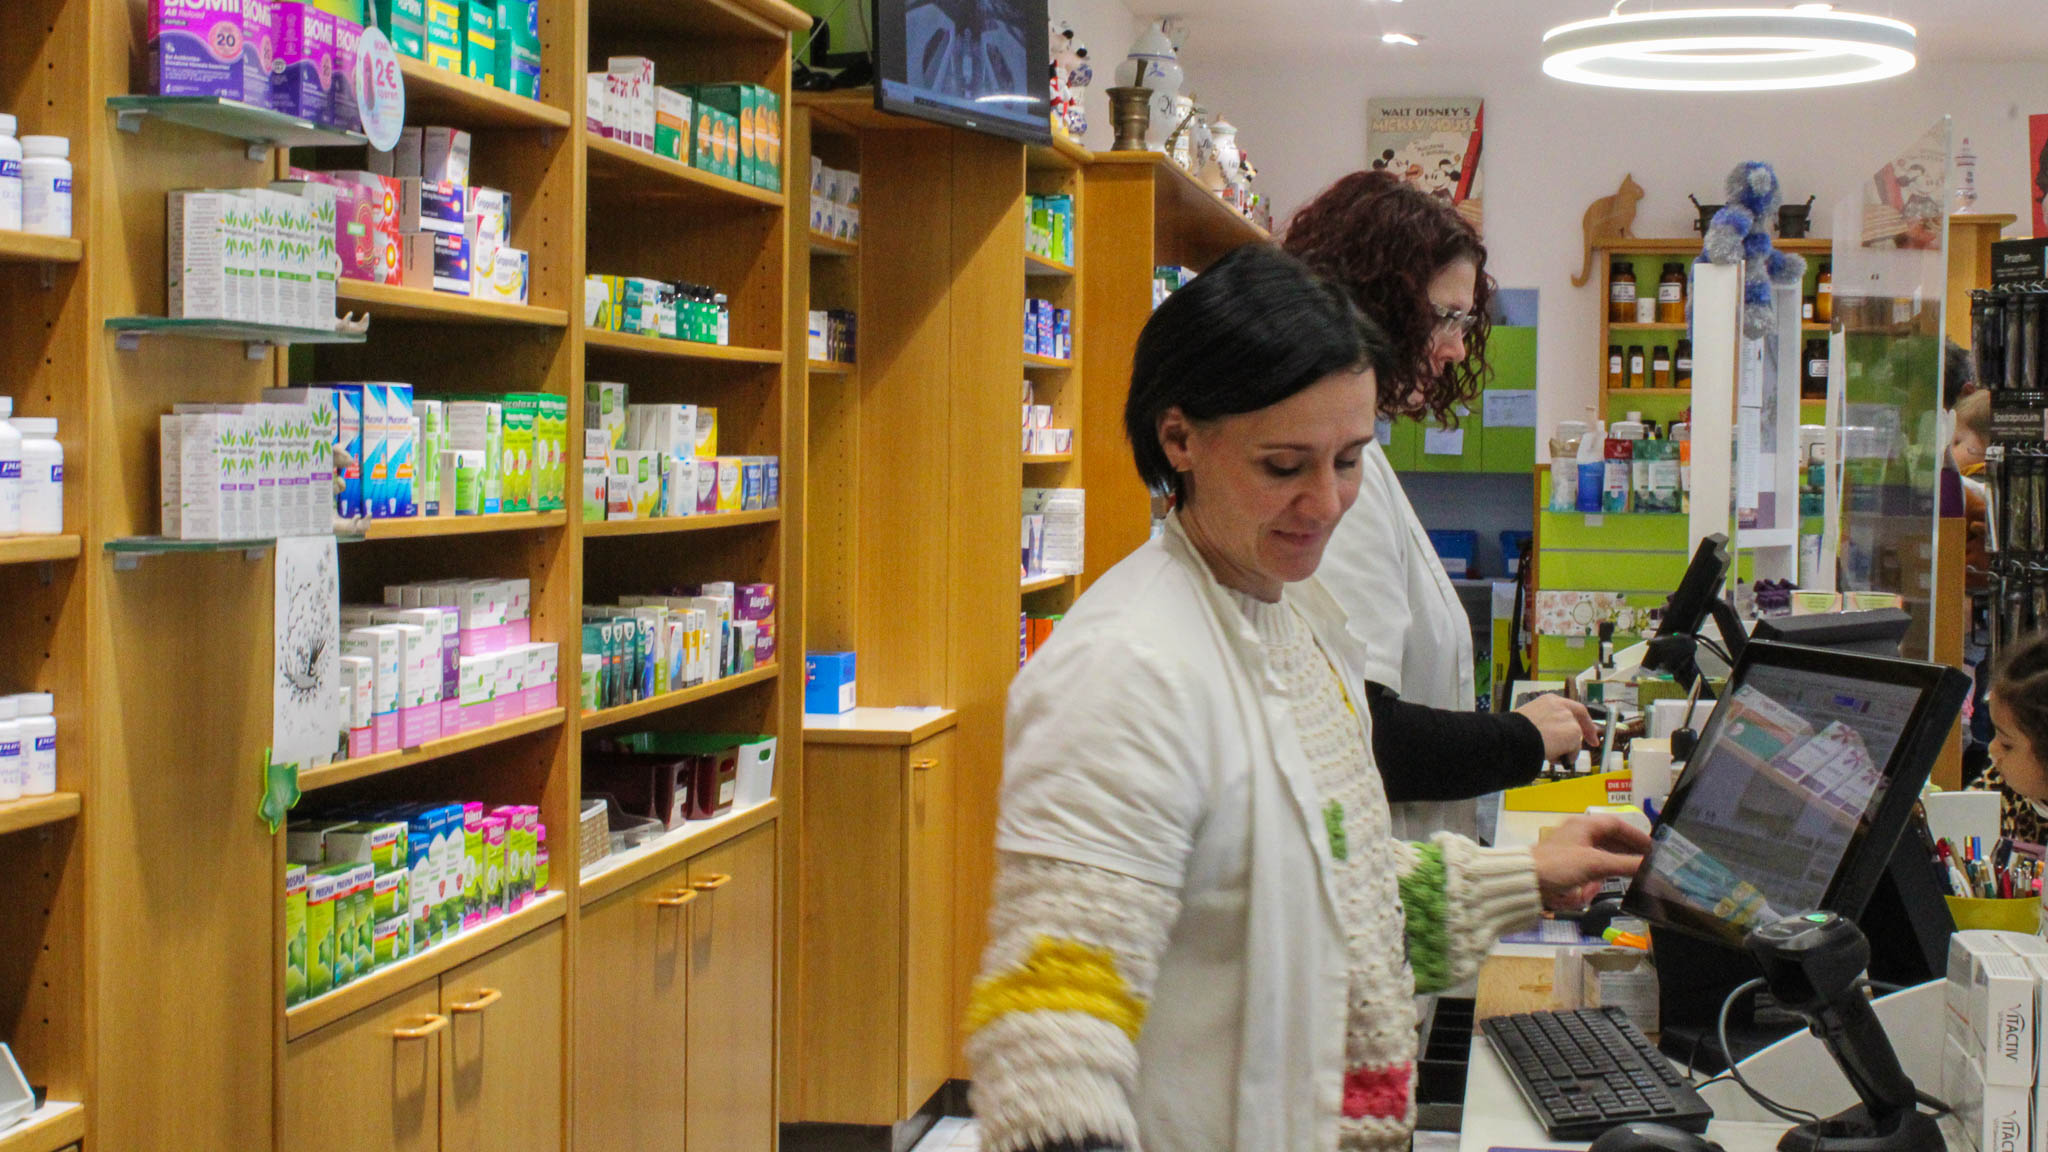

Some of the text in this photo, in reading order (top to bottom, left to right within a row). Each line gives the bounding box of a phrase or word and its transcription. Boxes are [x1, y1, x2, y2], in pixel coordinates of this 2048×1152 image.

[217, 33, 236, 47] 20
[376, 58, 397, 88] 2€
[1381, 107, 1471, 117] WALT DISNEY'S
[1372, 119, 1428, 132] MICKEY
[2005, 1003, 2025, 1063] VITACTIV
